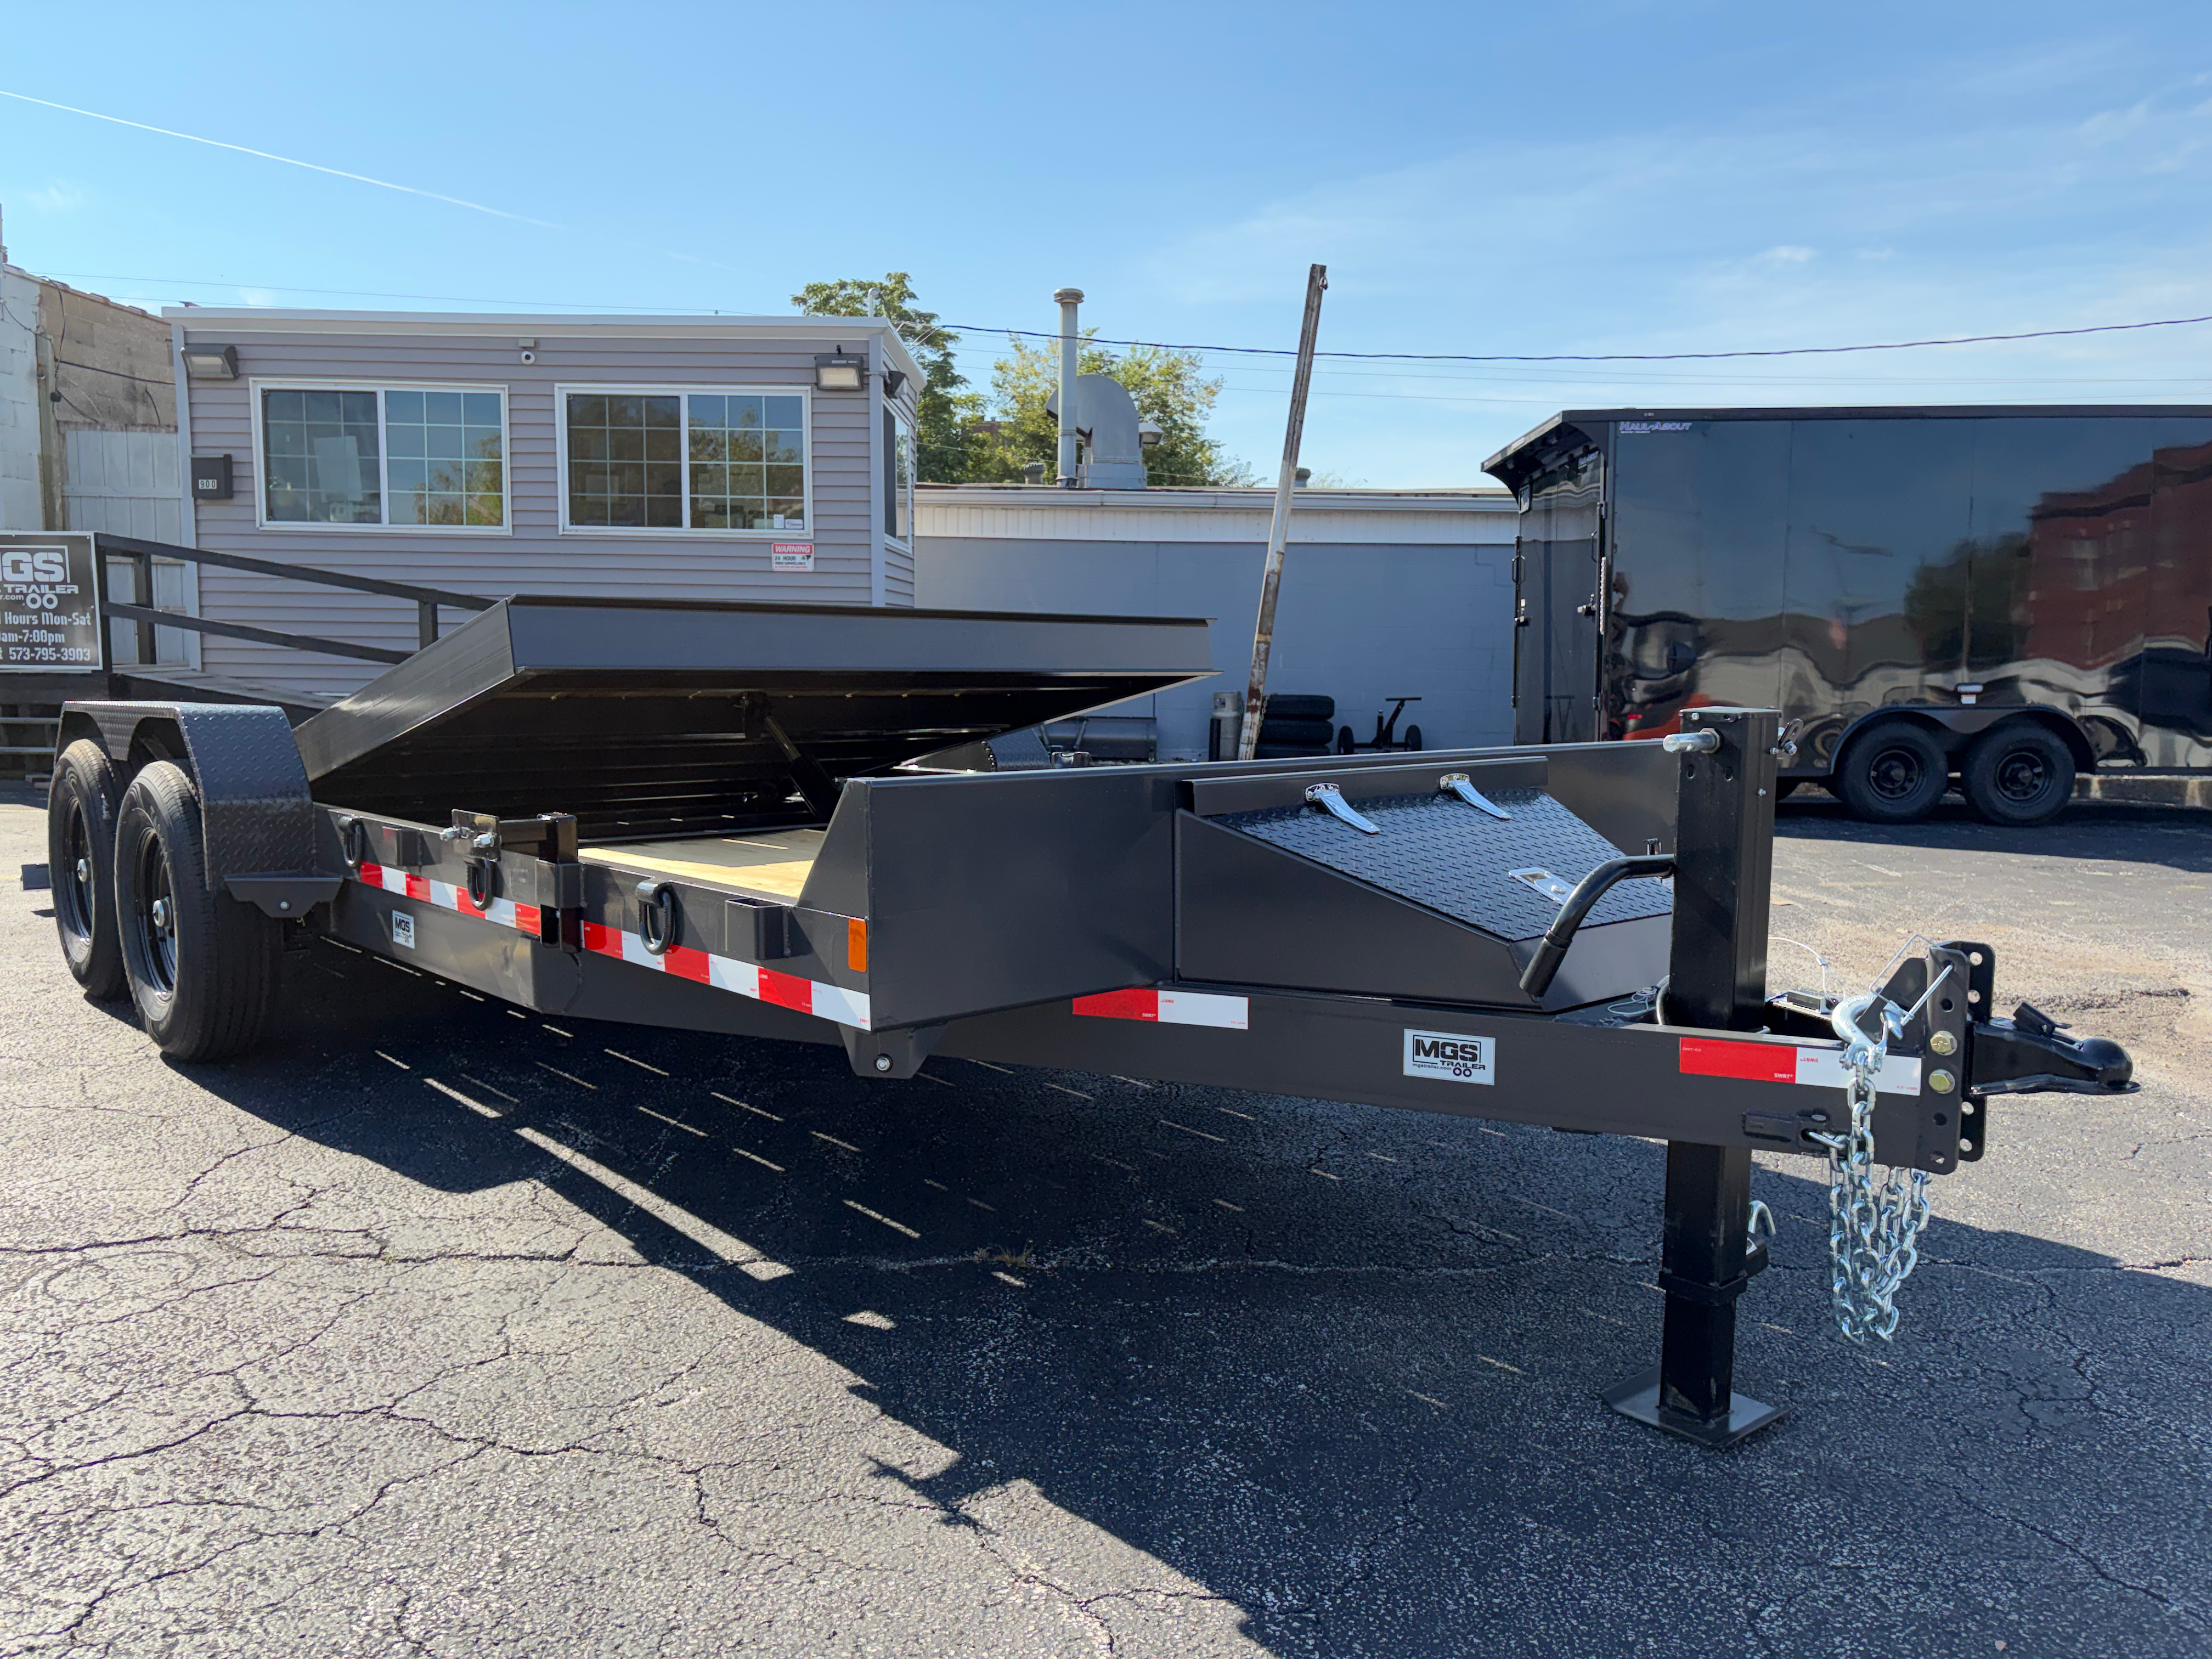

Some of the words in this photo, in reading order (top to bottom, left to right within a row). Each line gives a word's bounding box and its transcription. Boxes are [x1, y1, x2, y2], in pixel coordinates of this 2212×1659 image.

[200, 480, 216, 488] 900
[775, 545, 810, 554] WARNING
[0, 552, 65, 582] GS
[3, 584, 78, 594] TRAILER
[4, 611, 38, 625] Hours
[41, 612, 91, 626] Mon-Sat
[0, 629, 65, 646] am-7:00pm
[9, 647, 91, 661] 573-795-3903
[395, 917, 410, 933] MGS
[1415, 1039, 1478, 1062] MGS
[1440, 1060, 1486, 1070] TRAILER
